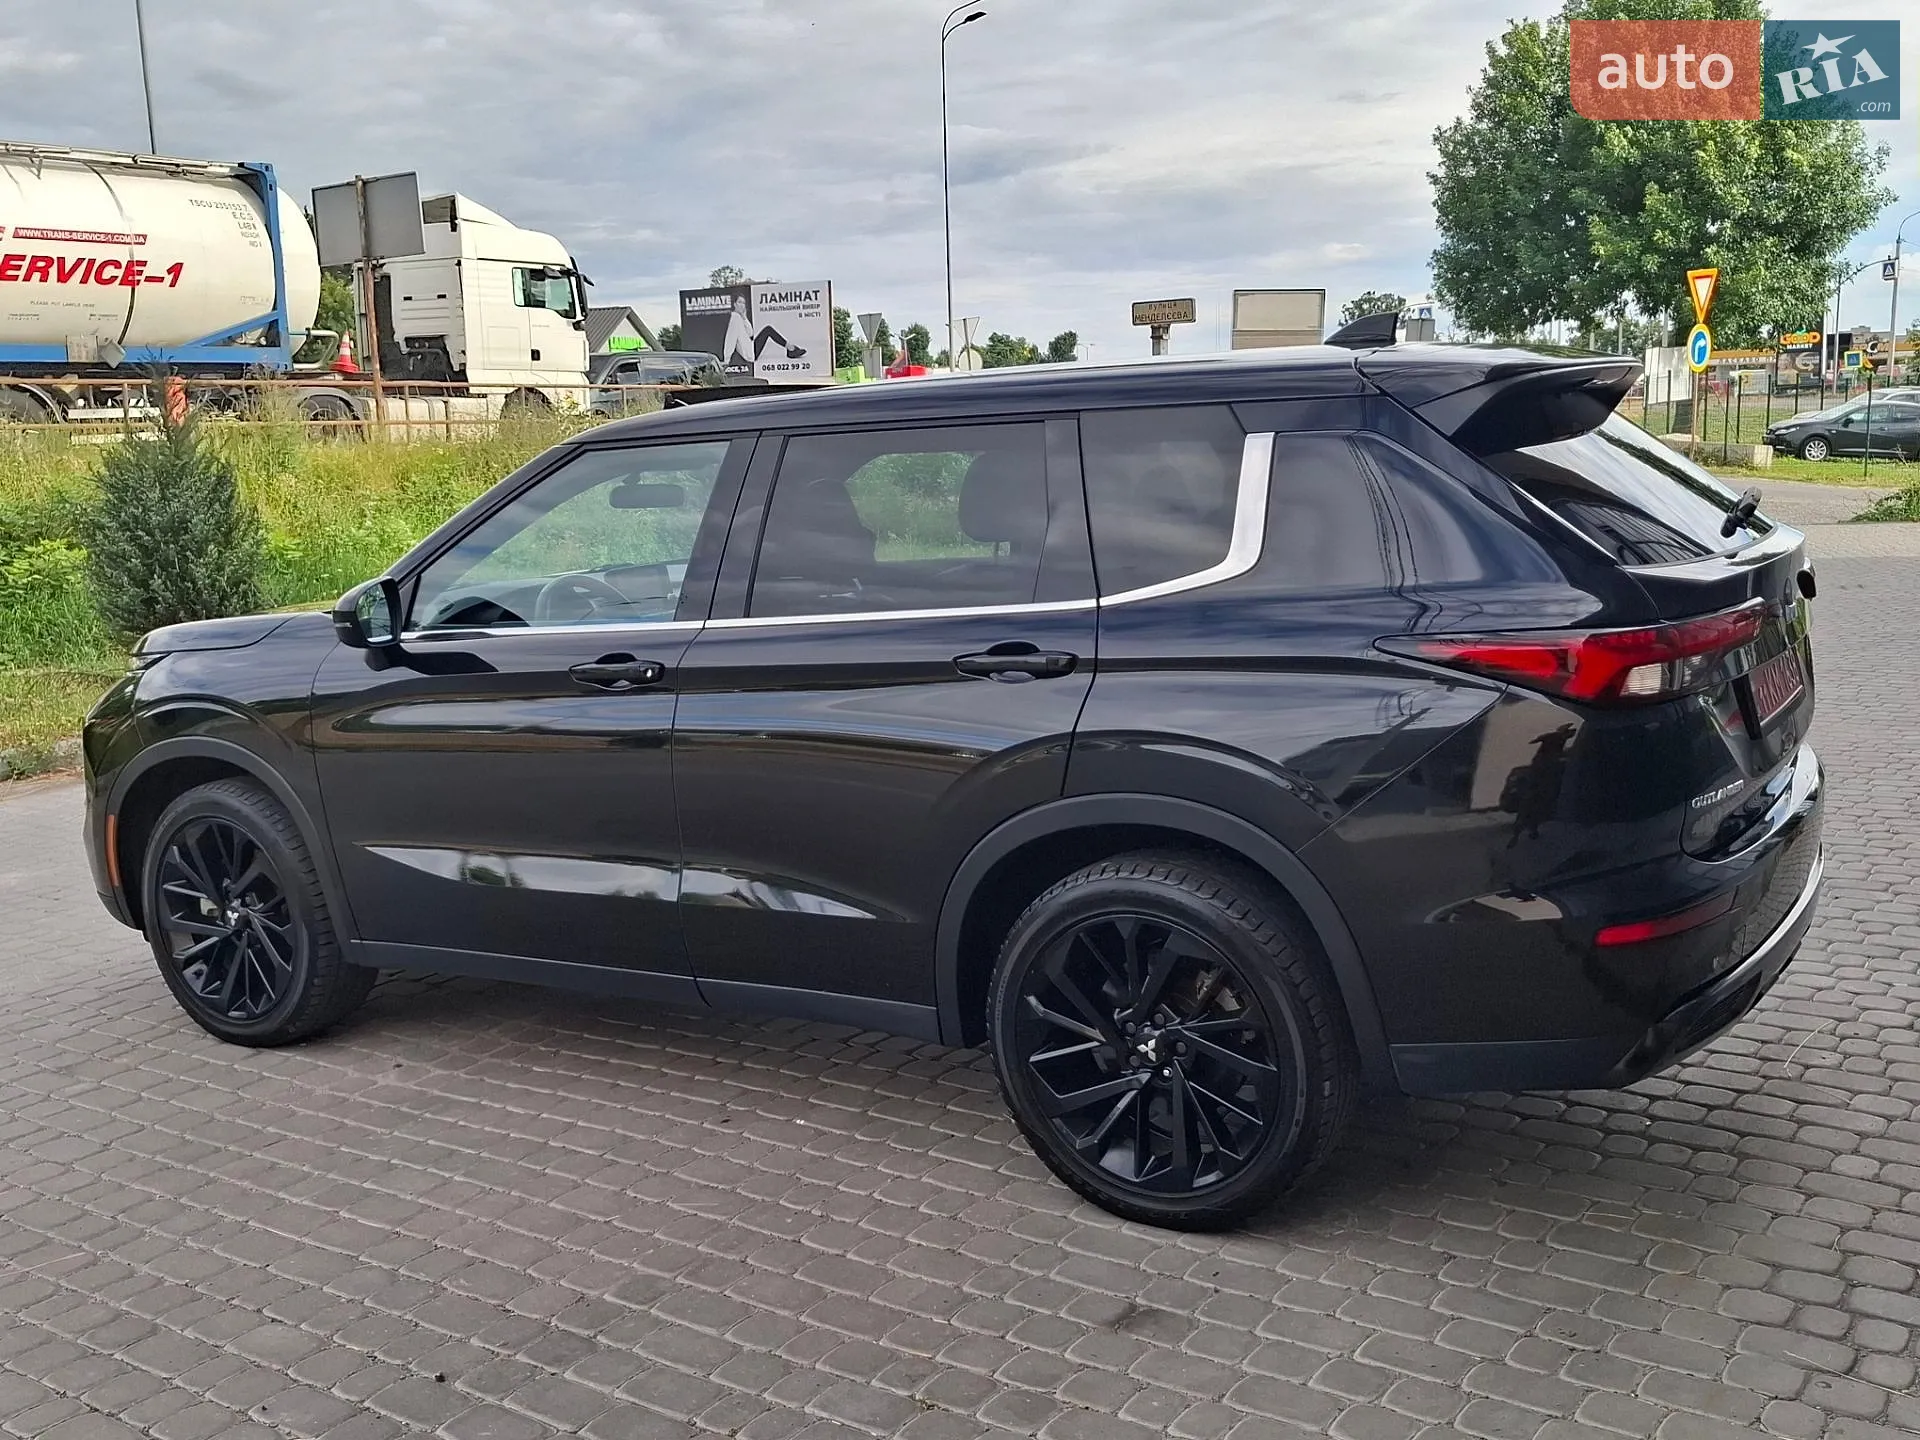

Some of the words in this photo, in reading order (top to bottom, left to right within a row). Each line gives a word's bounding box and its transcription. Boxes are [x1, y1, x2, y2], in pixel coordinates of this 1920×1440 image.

[0, 253, 184, 288] ERVICE-1
[685, 294, 731, 307] LAMINATE
[760, 290, 820, 304] ЛАМІНАТ
[1781, 332, 1821, 344] GOOD
[776, 363, 789, 371] 022
[802, 362, 811, 370] 20
[1691, 779, 1744, 809] OUTLANDER
